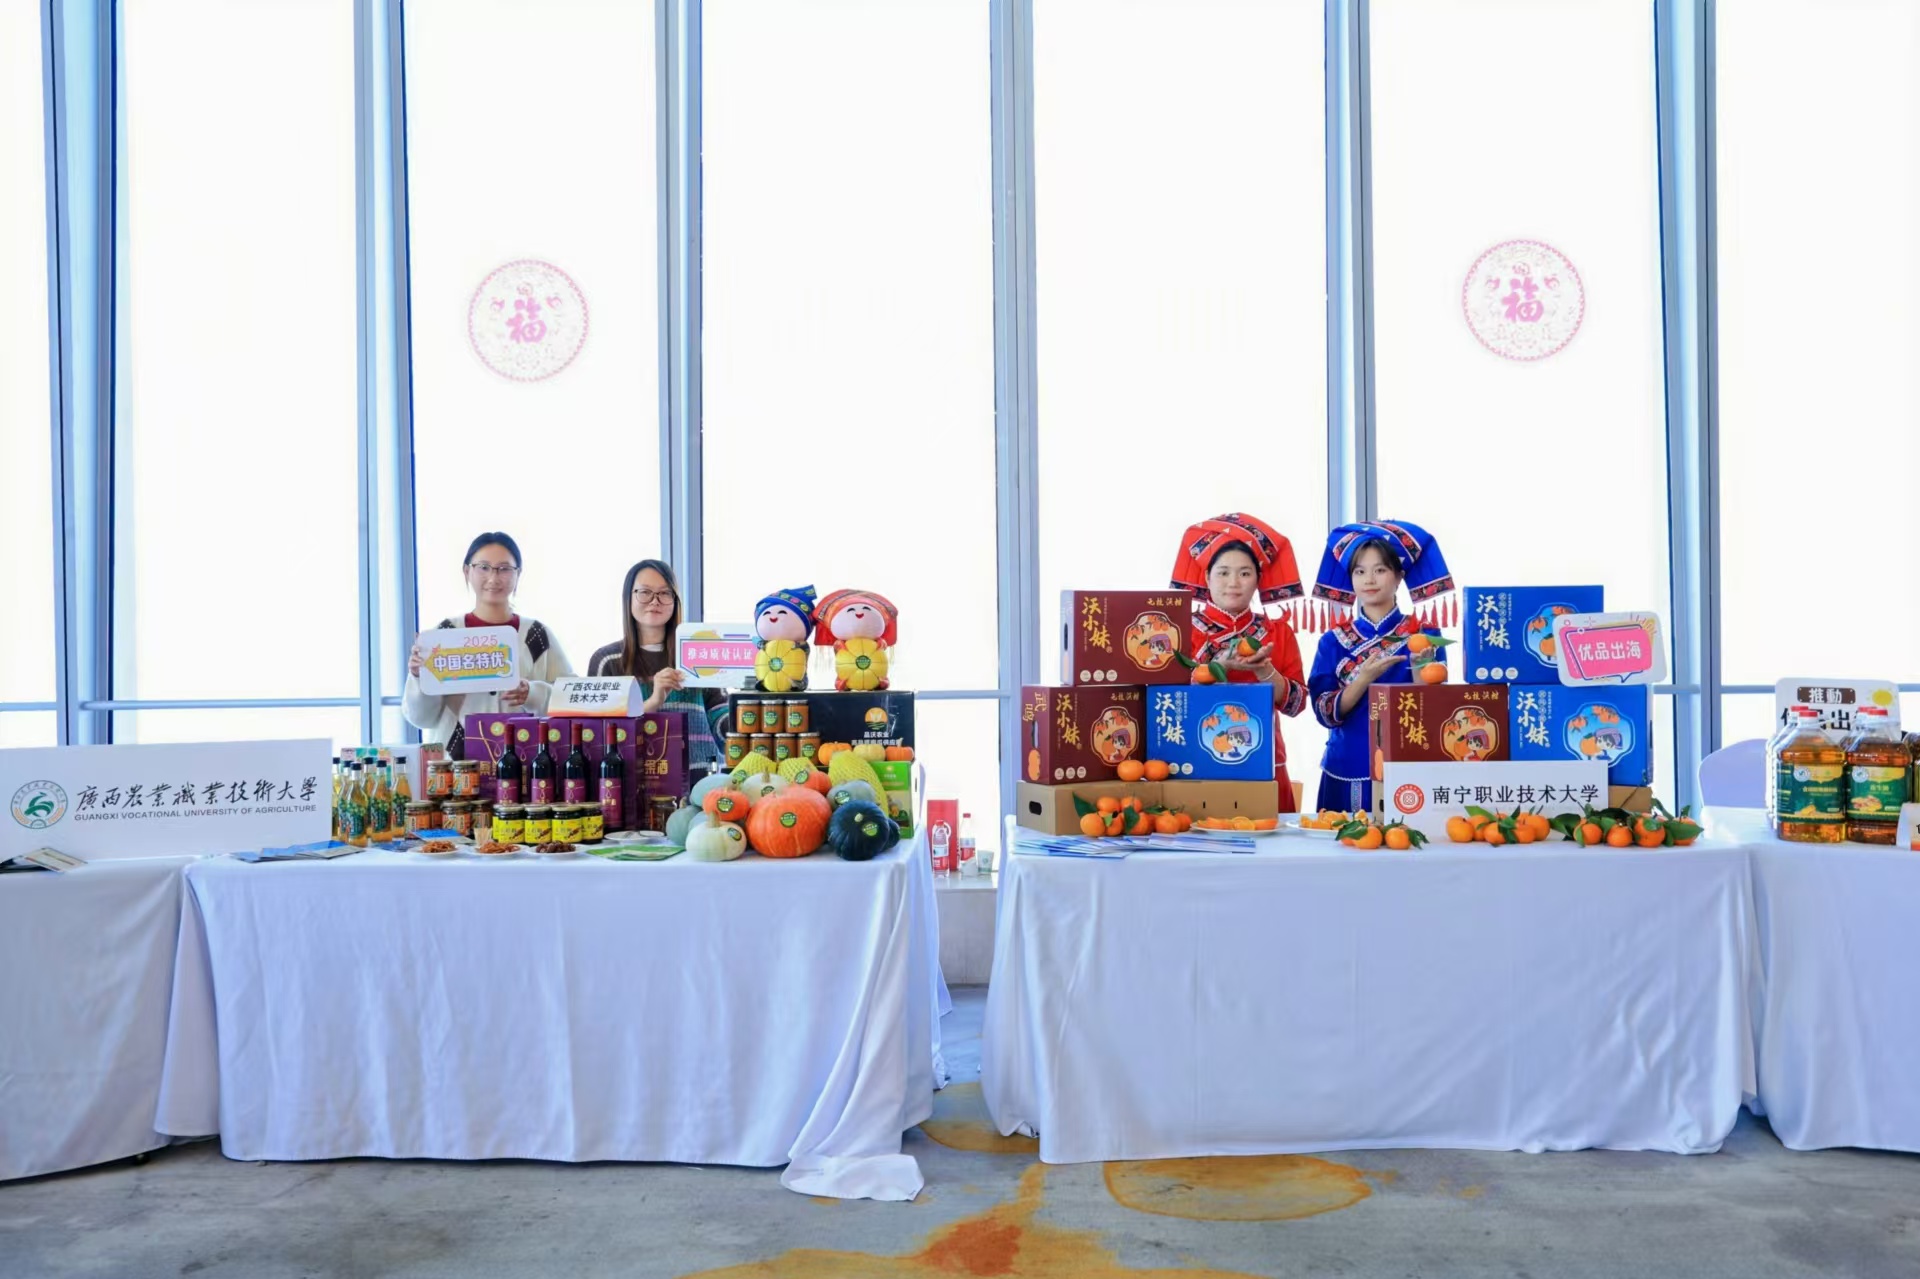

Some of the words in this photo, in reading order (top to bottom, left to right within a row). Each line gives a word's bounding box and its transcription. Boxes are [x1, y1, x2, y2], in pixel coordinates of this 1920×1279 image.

[1501, 276, 1544, 323] 福
[505, 297, 547, 344] 福
[1081, 596, 1111, 649] 沃小妹
[1475, 594, 1509, 648] 沃小妹
[463, 634, 498, 647] 2025
[1578, 640, 1642, 661] 优品出海
[433, 651, 505, 672] 中国名特优
[687, 647, 753, 660] 推动质量认证
[562, 682, 621, 692] 广西农业职业
[1808, 687, 1842, 704] 推動
[569, 693, 609, 703] 技术大学
[1055, 693, 1080, 745] 沃小妹
[1154, 691, 1185, 745] 沃小妹
[1397, 691, 1427, 746] 沃小妹
[1515, 691, 1549, 747] 沃小妹
[1432, 784, 1600, 804] 南宁职业技术大学
[74, 812, 119, 821] GUANGXI
[121, 810, 181, 819] VOCATIONAL
[184, 807, 238, 817] UNIVERSITY
[255, 804, 317, 813] AGRICULTURE
